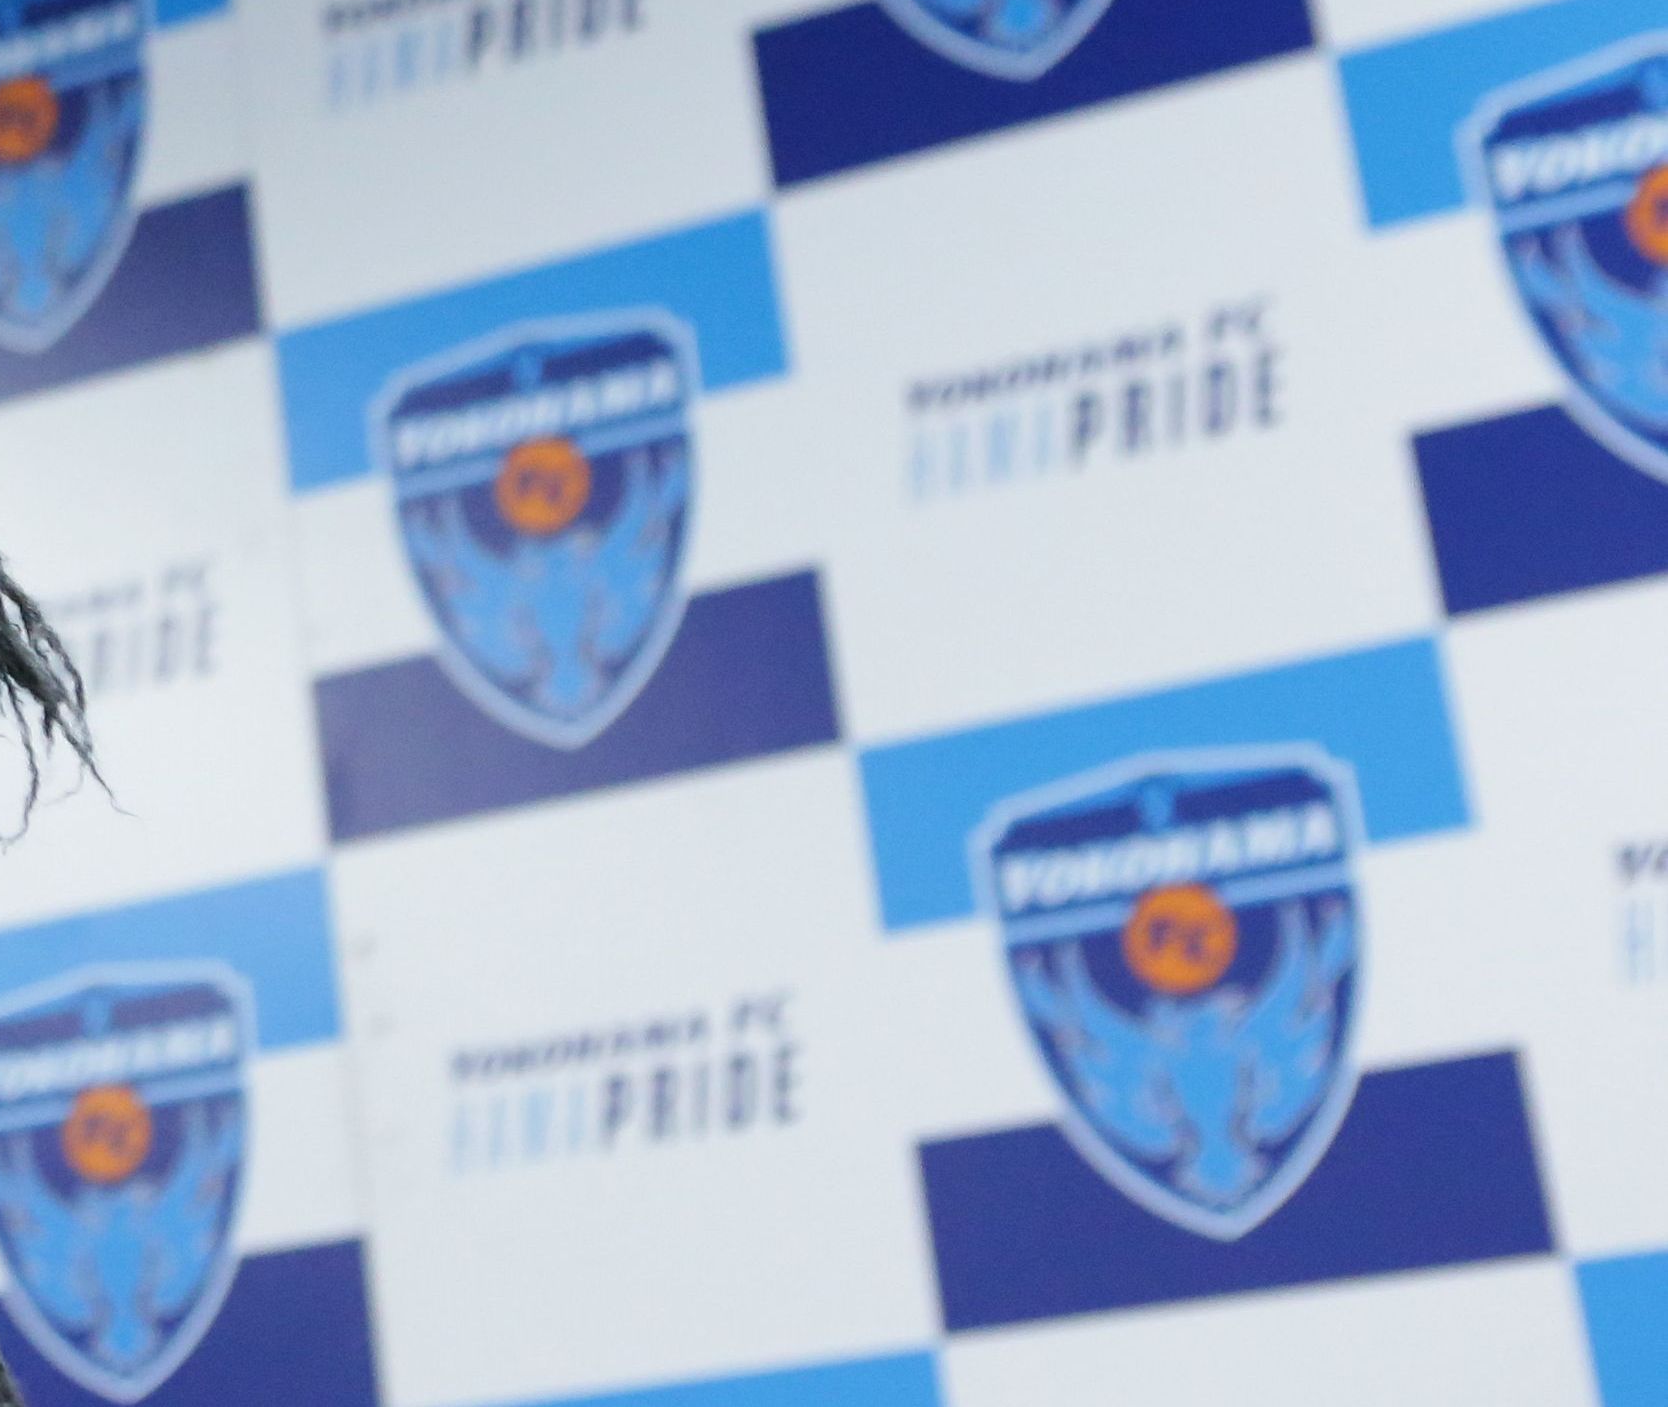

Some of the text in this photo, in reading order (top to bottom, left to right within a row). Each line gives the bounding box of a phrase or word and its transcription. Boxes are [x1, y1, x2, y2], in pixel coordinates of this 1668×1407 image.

[1066, 342, 1284, 474] PRIDE
[999, 795, 1341, 912] YOKOHAMA
[599, 1038, 804, 1154] PRIDE
